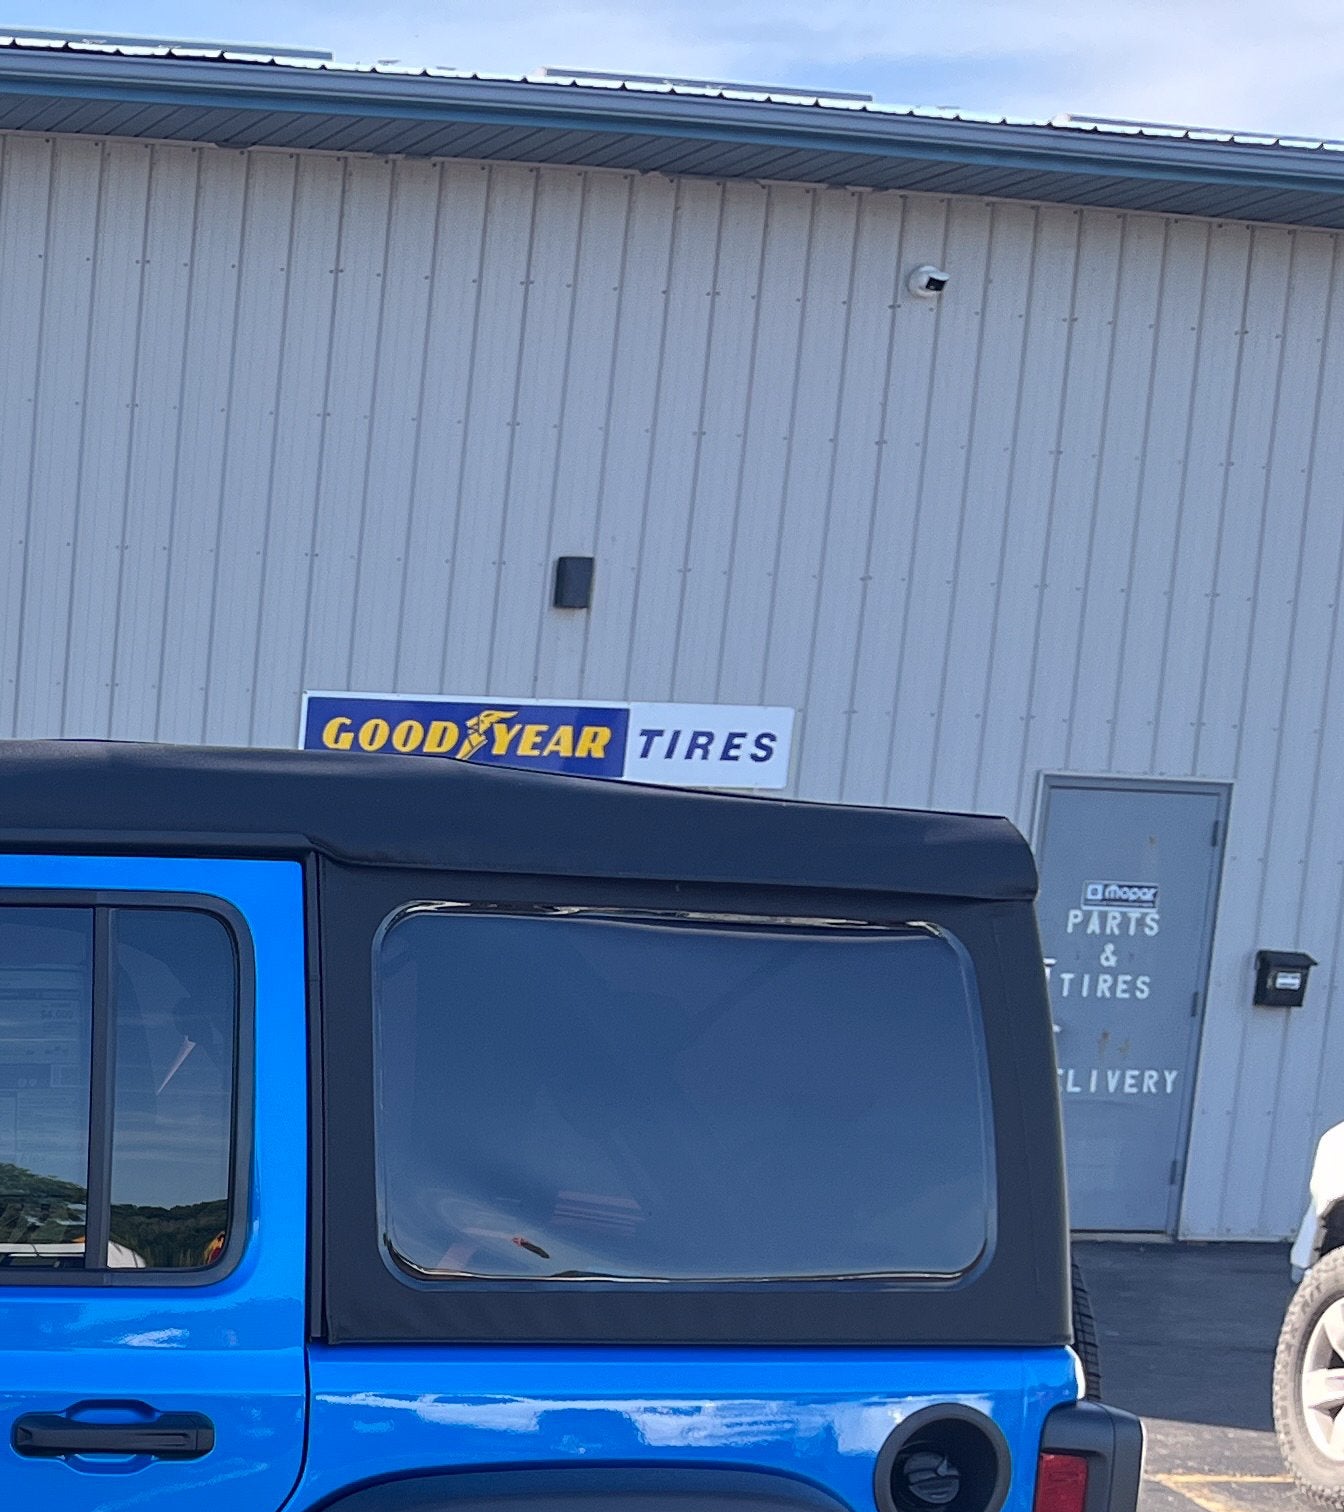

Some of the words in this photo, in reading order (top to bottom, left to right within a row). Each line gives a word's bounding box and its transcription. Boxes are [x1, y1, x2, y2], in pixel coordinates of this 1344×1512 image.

[321, 712, 612, 759] GOODYEAR
[638, 728, 778, 763] TIRES
[1066, 908, 1160, 937] PARTS
[1099, 942, 1118, 967] &
[1059, 972, 1151, 999] TIRES
[1056, 1068, 1178, 1094] LIVERY
